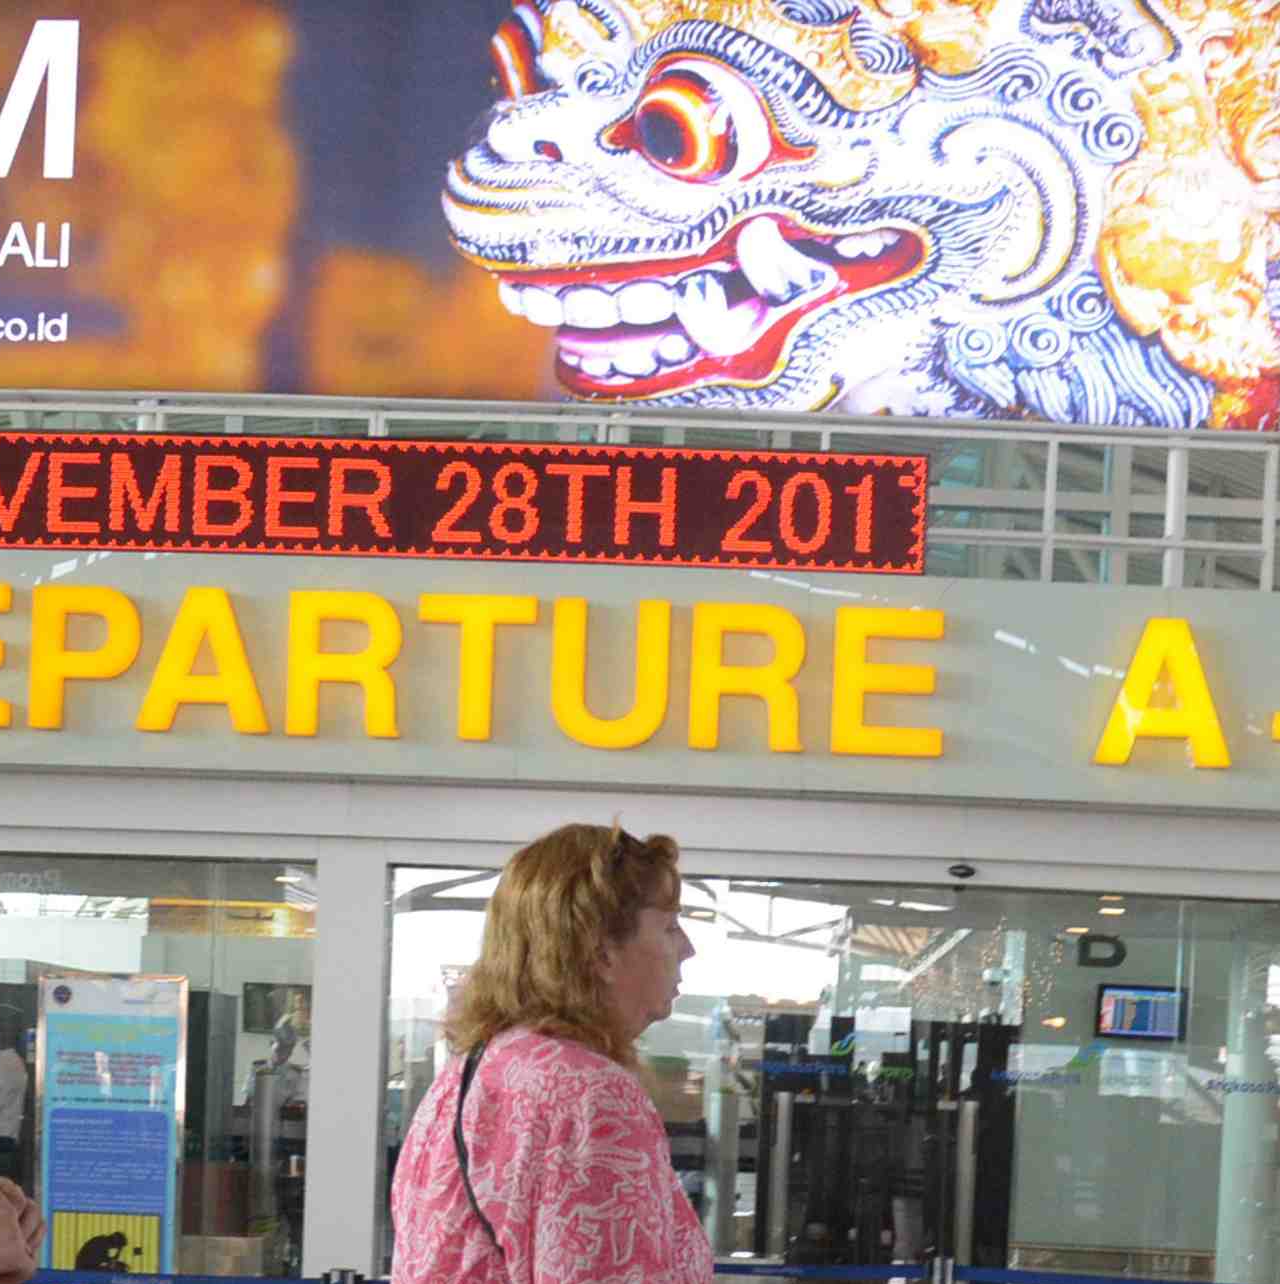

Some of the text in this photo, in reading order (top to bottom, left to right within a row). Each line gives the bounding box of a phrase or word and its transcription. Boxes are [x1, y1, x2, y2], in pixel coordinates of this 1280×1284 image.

[431, 461, 678, 547] 28TH
[720, 468, 874, 555] 201
[1092, 616, 1231, 768] A
